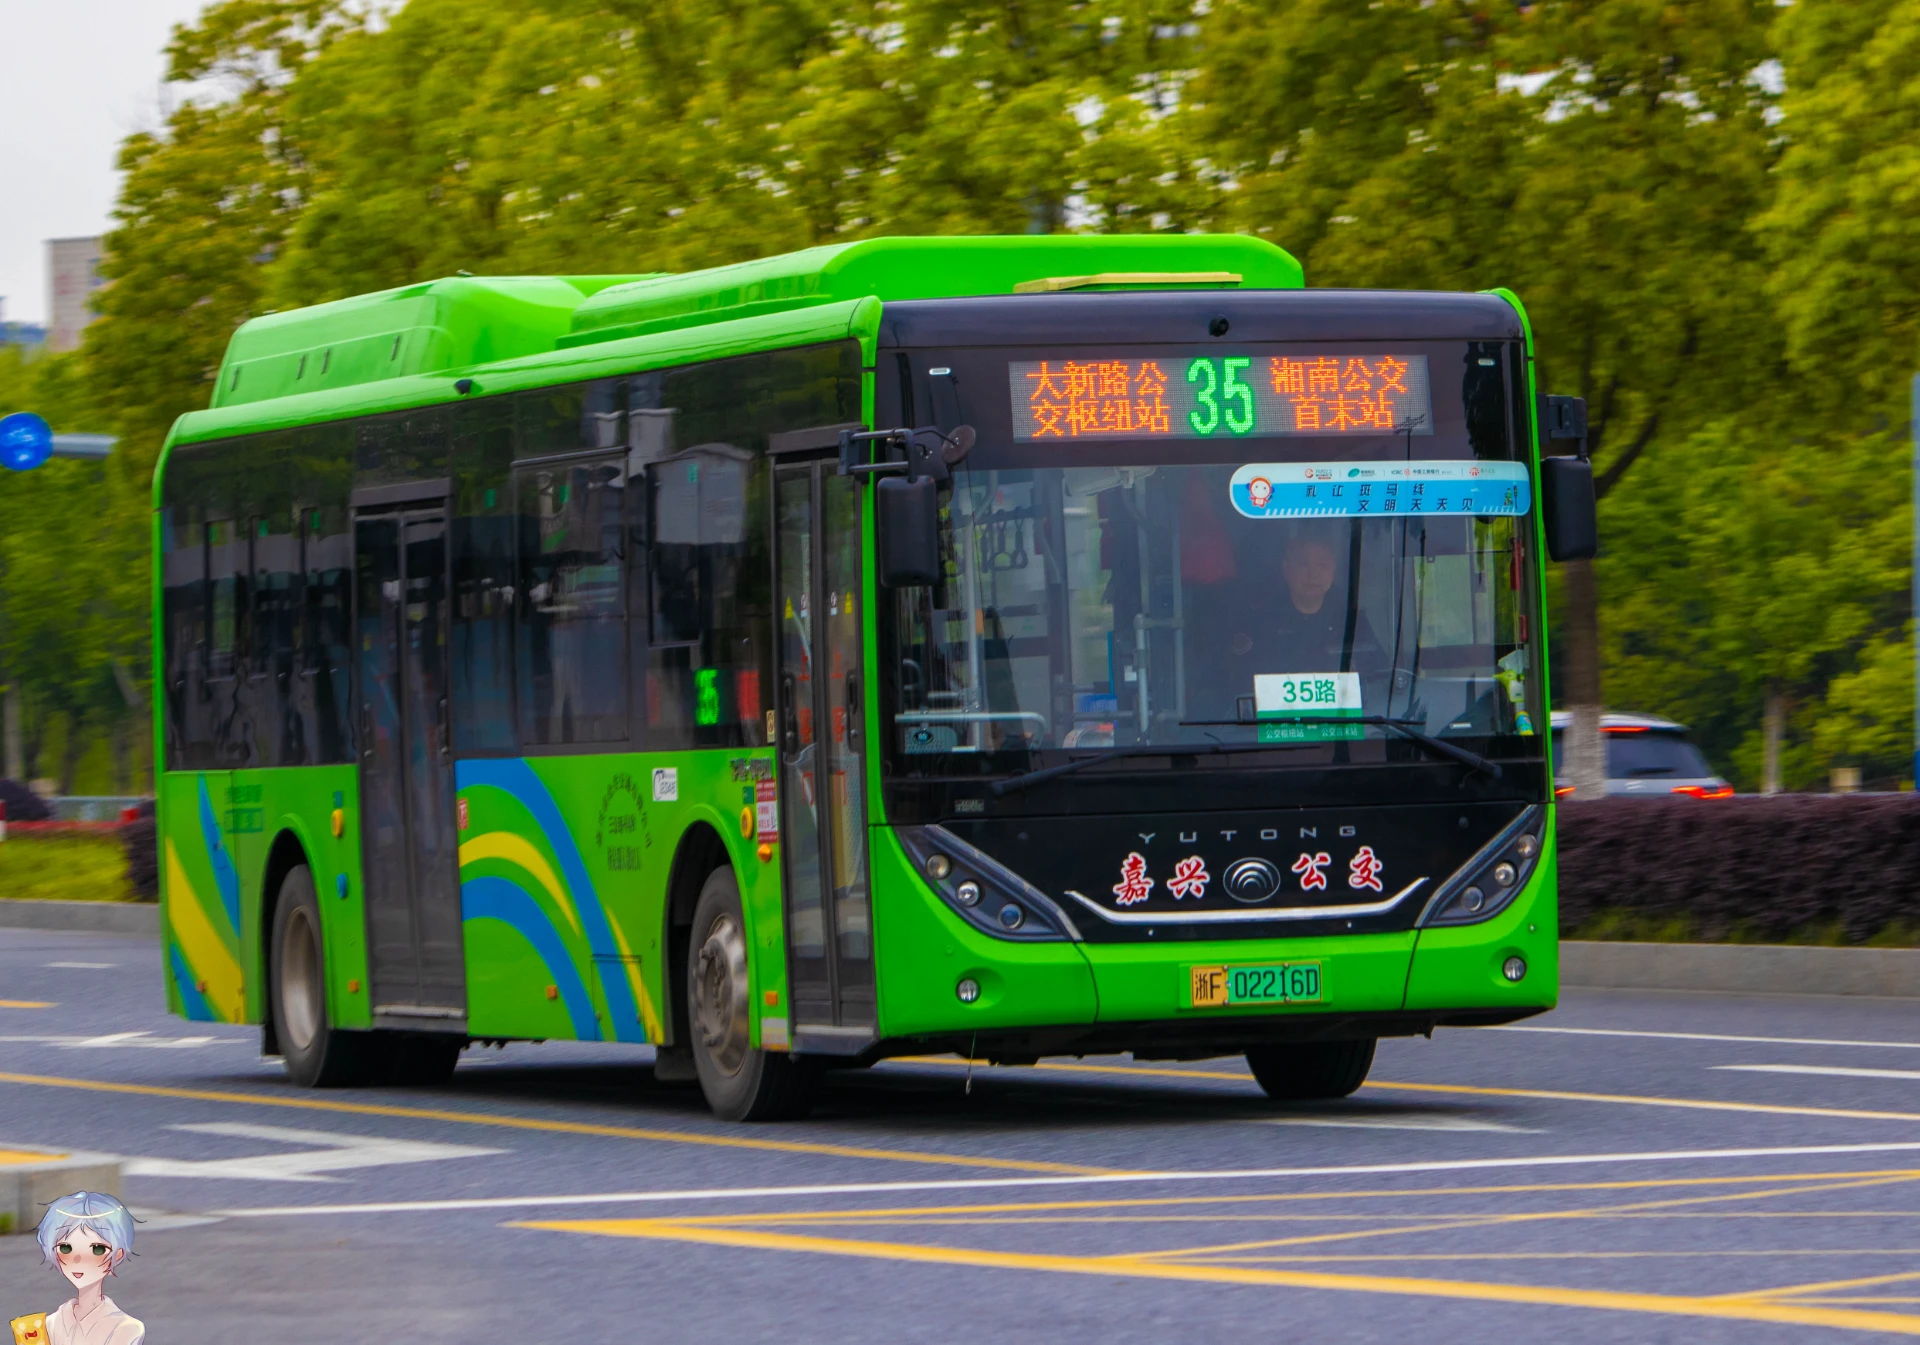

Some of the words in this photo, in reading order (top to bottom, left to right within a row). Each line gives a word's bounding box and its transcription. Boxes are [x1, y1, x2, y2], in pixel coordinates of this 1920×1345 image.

[1026, 360, 1168, 400] 大新路公
[1269, 355, 1408, 393] 湘南公交
[1188, 357, 1255, 434] 35
[1288, 391, 1394, 431] 首末站
[1030, 396, 1170, 437] 交枢纽站
[1305, 483, 1425, 498] 礼让斑马线
[1358, 498, 1474, 512] 文明天天见
[1282, 678, 1336, 703] 35路
[1138, 825, 1356, 844] YUTONG
